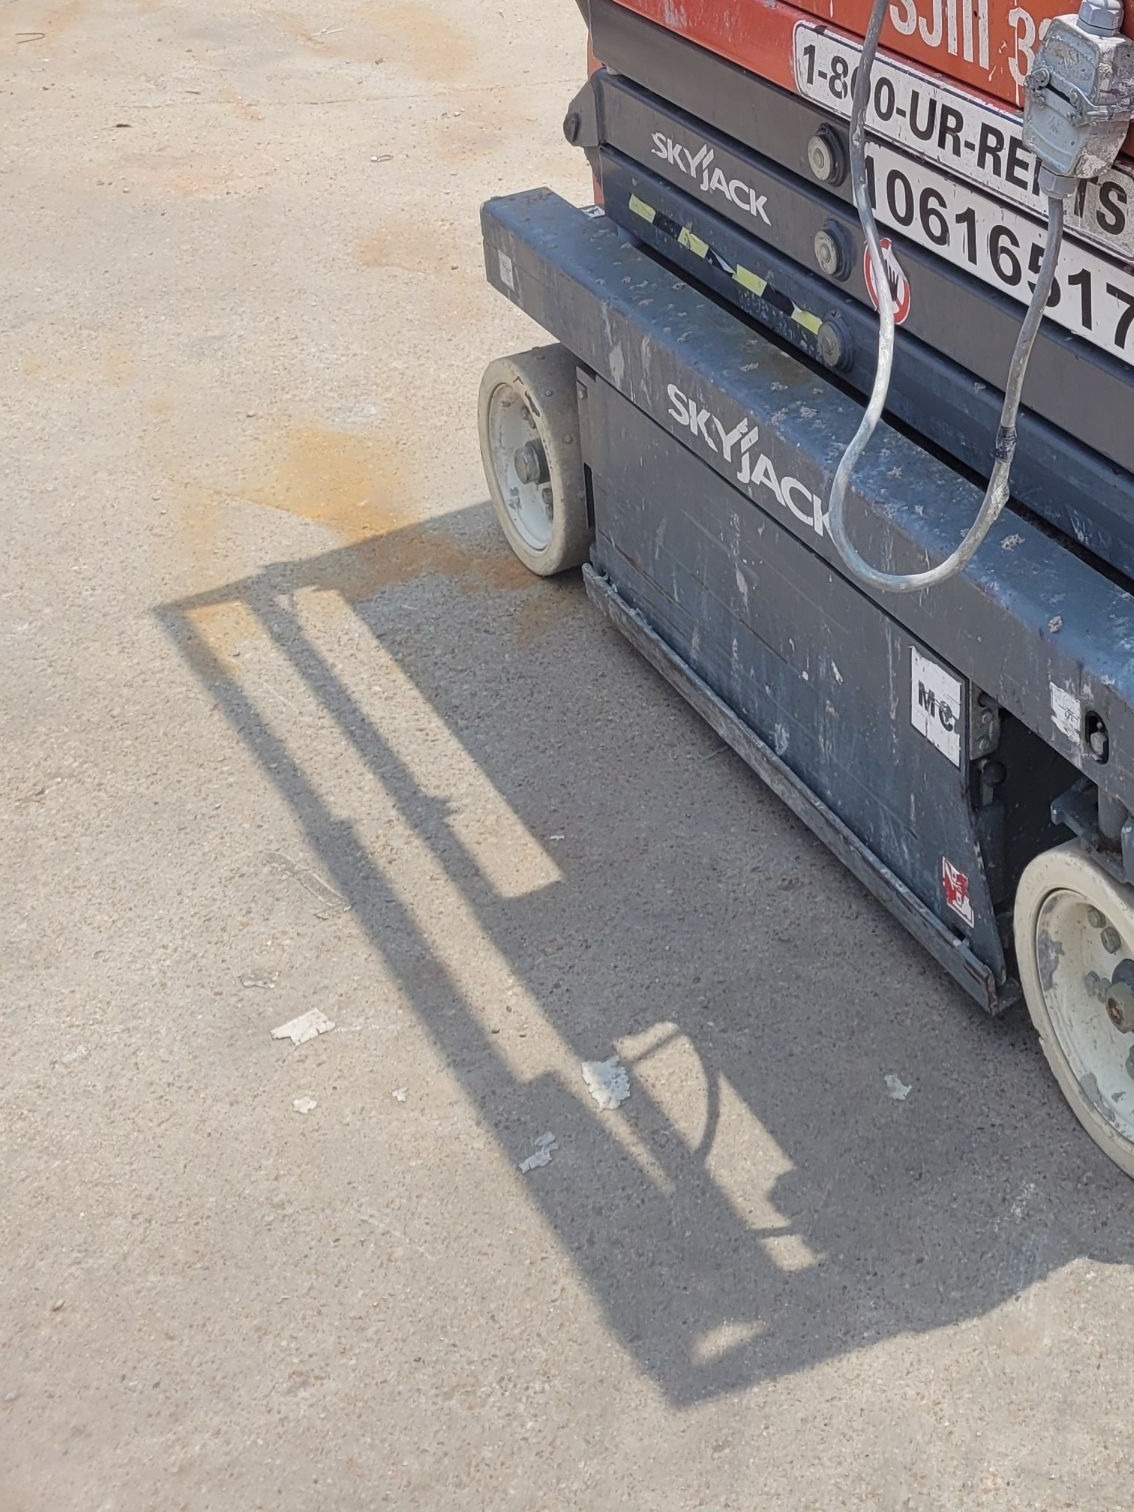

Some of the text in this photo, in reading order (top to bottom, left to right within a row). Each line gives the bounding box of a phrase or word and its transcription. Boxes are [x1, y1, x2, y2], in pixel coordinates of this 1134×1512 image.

[1007, 6, 1053, 87] 3
[650, 131, 772, 227] SKYJACK
[667, 383, 839, 544] SKYJACK
